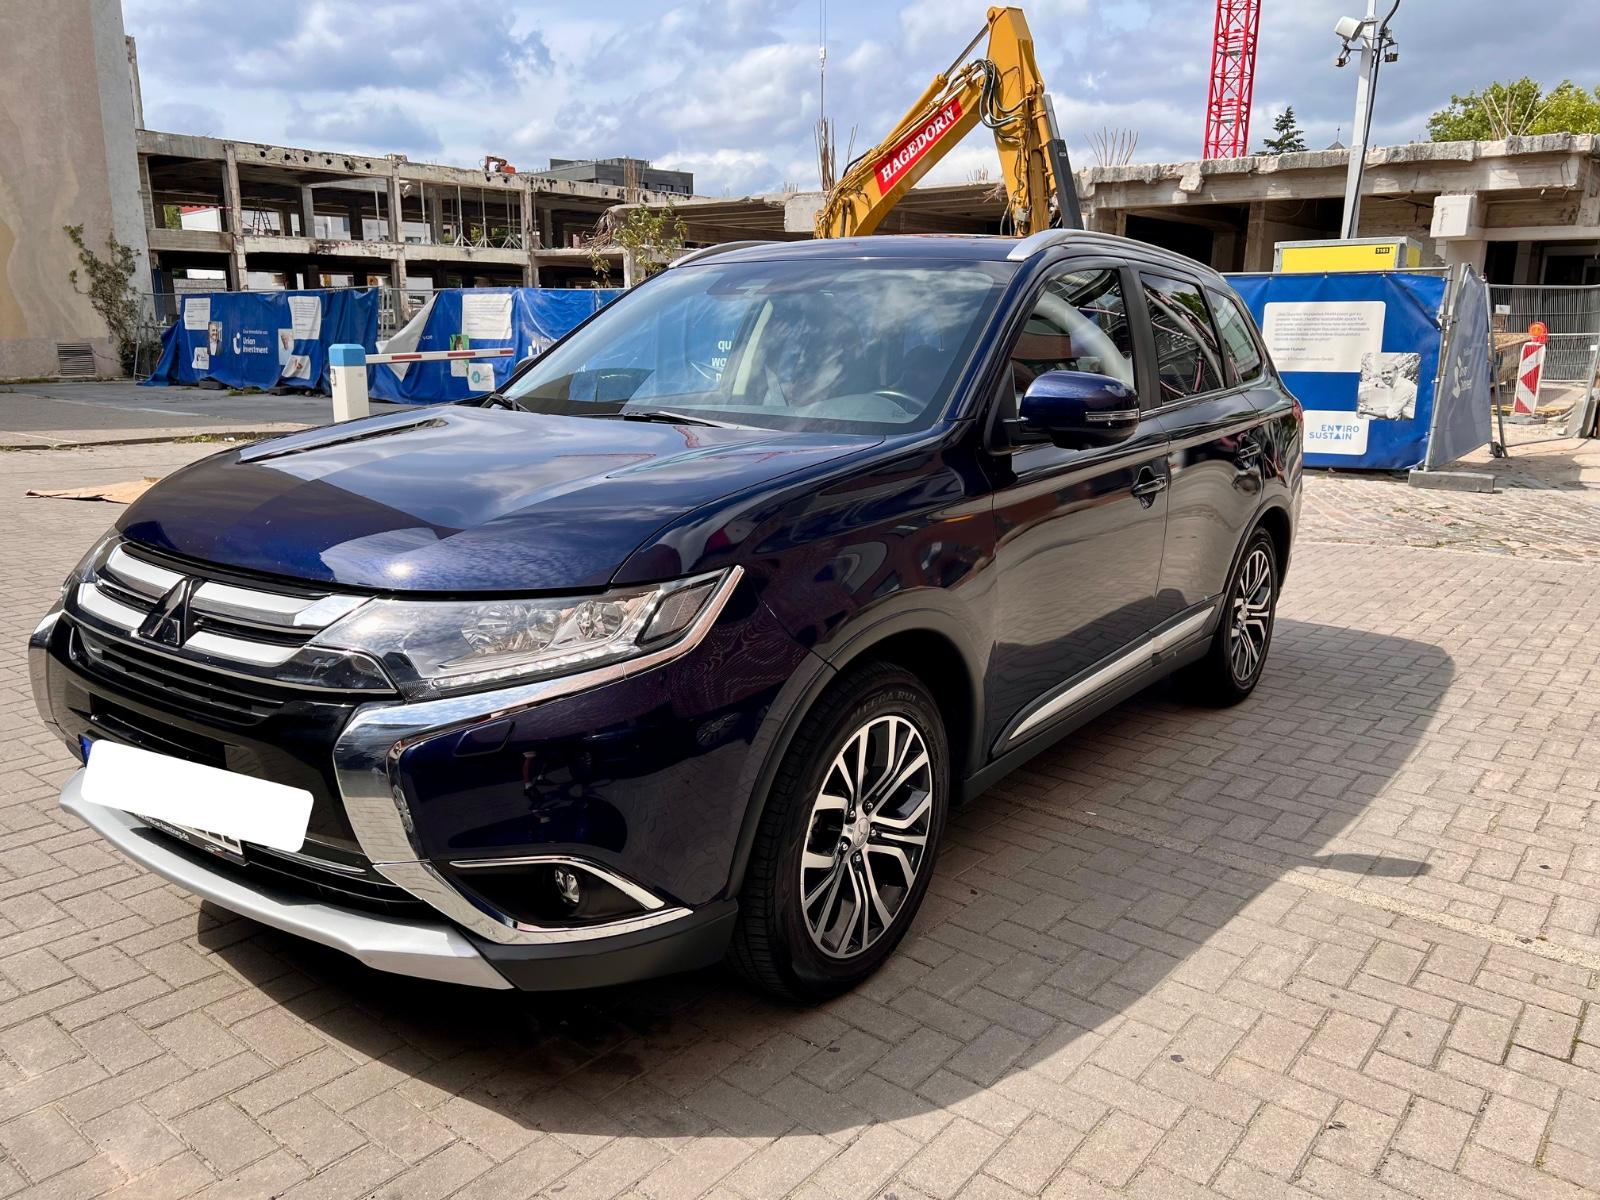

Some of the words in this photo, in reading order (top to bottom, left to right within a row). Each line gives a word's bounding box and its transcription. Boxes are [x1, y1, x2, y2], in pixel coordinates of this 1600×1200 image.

[880, 105, 956, 183] HAGEDORN
[242, 336, 256, 345] Union
[242, 345, 269, 354] Investment
[1321, 424, 1360, 433] ENVIRO
[1309, 432, 1352, 440] SUSTAIN
